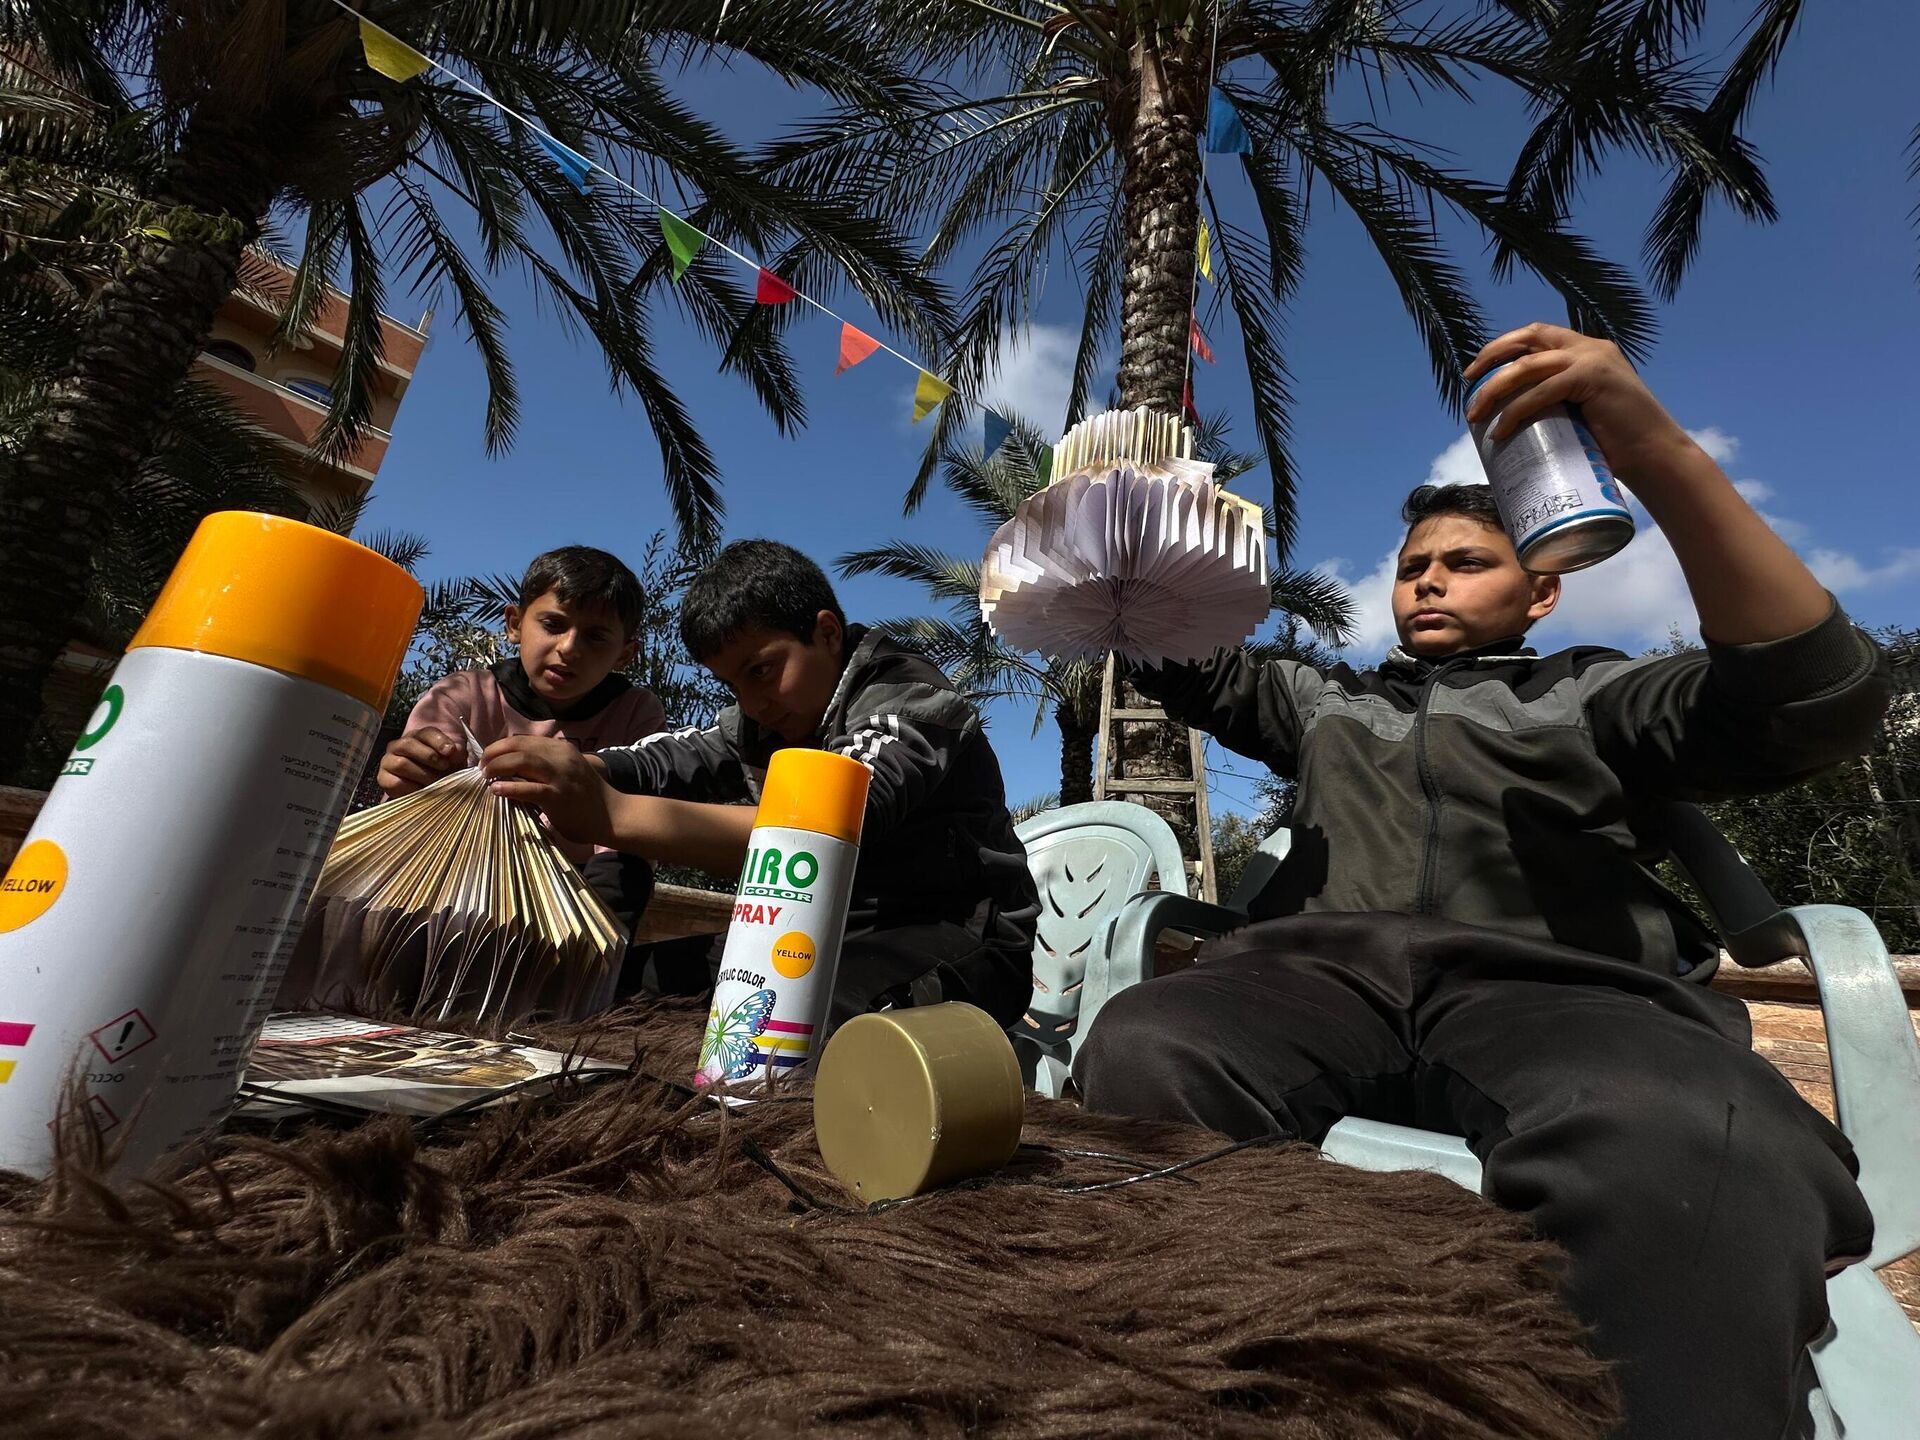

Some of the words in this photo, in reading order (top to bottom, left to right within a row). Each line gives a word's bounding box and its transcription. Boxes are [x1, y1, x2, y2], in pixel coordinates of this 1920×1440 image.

[745, 887, 812, 902] COLOR
[776, 948, 812, 960] YELLOW
[715, 967, 736, 987] RYLIC
[736, 968, 766, 990] COLOR
